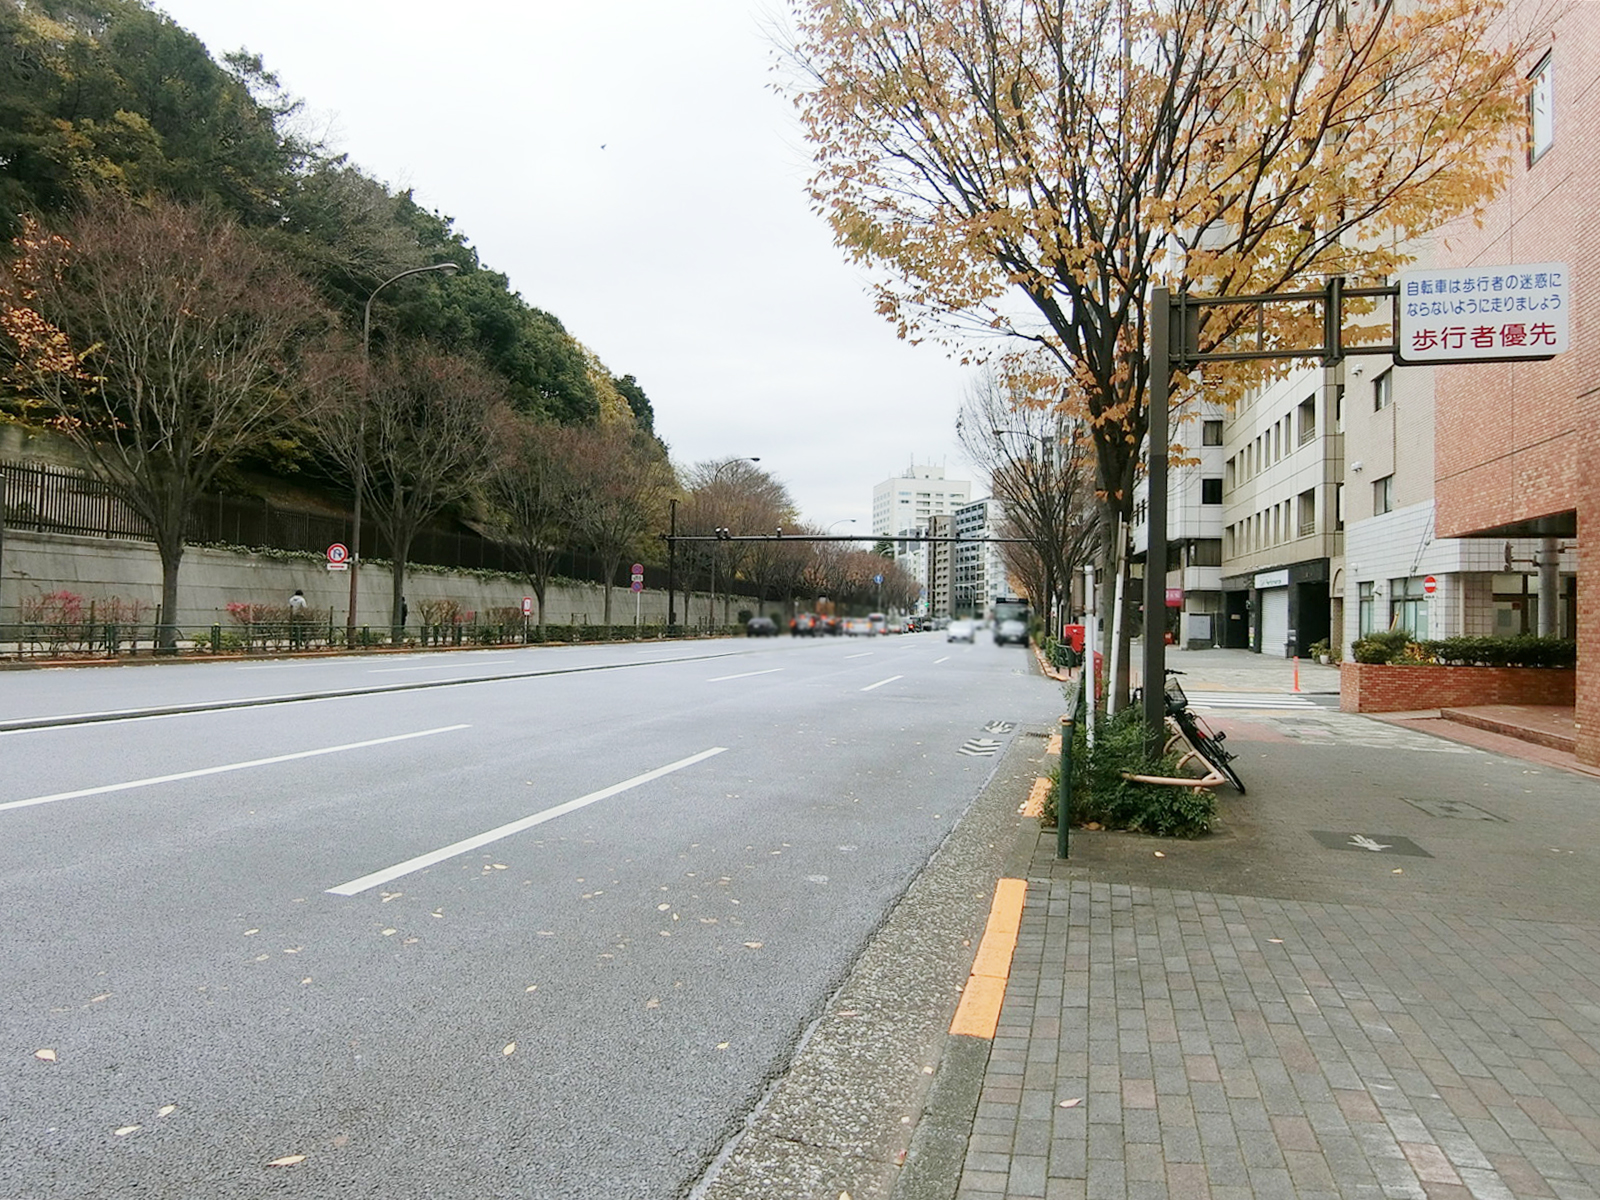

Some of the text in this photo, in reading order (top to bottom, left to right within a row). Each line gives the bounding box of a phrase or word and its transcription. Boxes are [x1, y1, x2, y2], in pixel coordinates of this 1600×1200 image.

[1407, 272, 1562, 296] 自転車は歩行者の迷惑に
[1407, 293, 1562, 317] ならないように走りましょう
[1412, 321, 1557, 351] 歩行者優先
